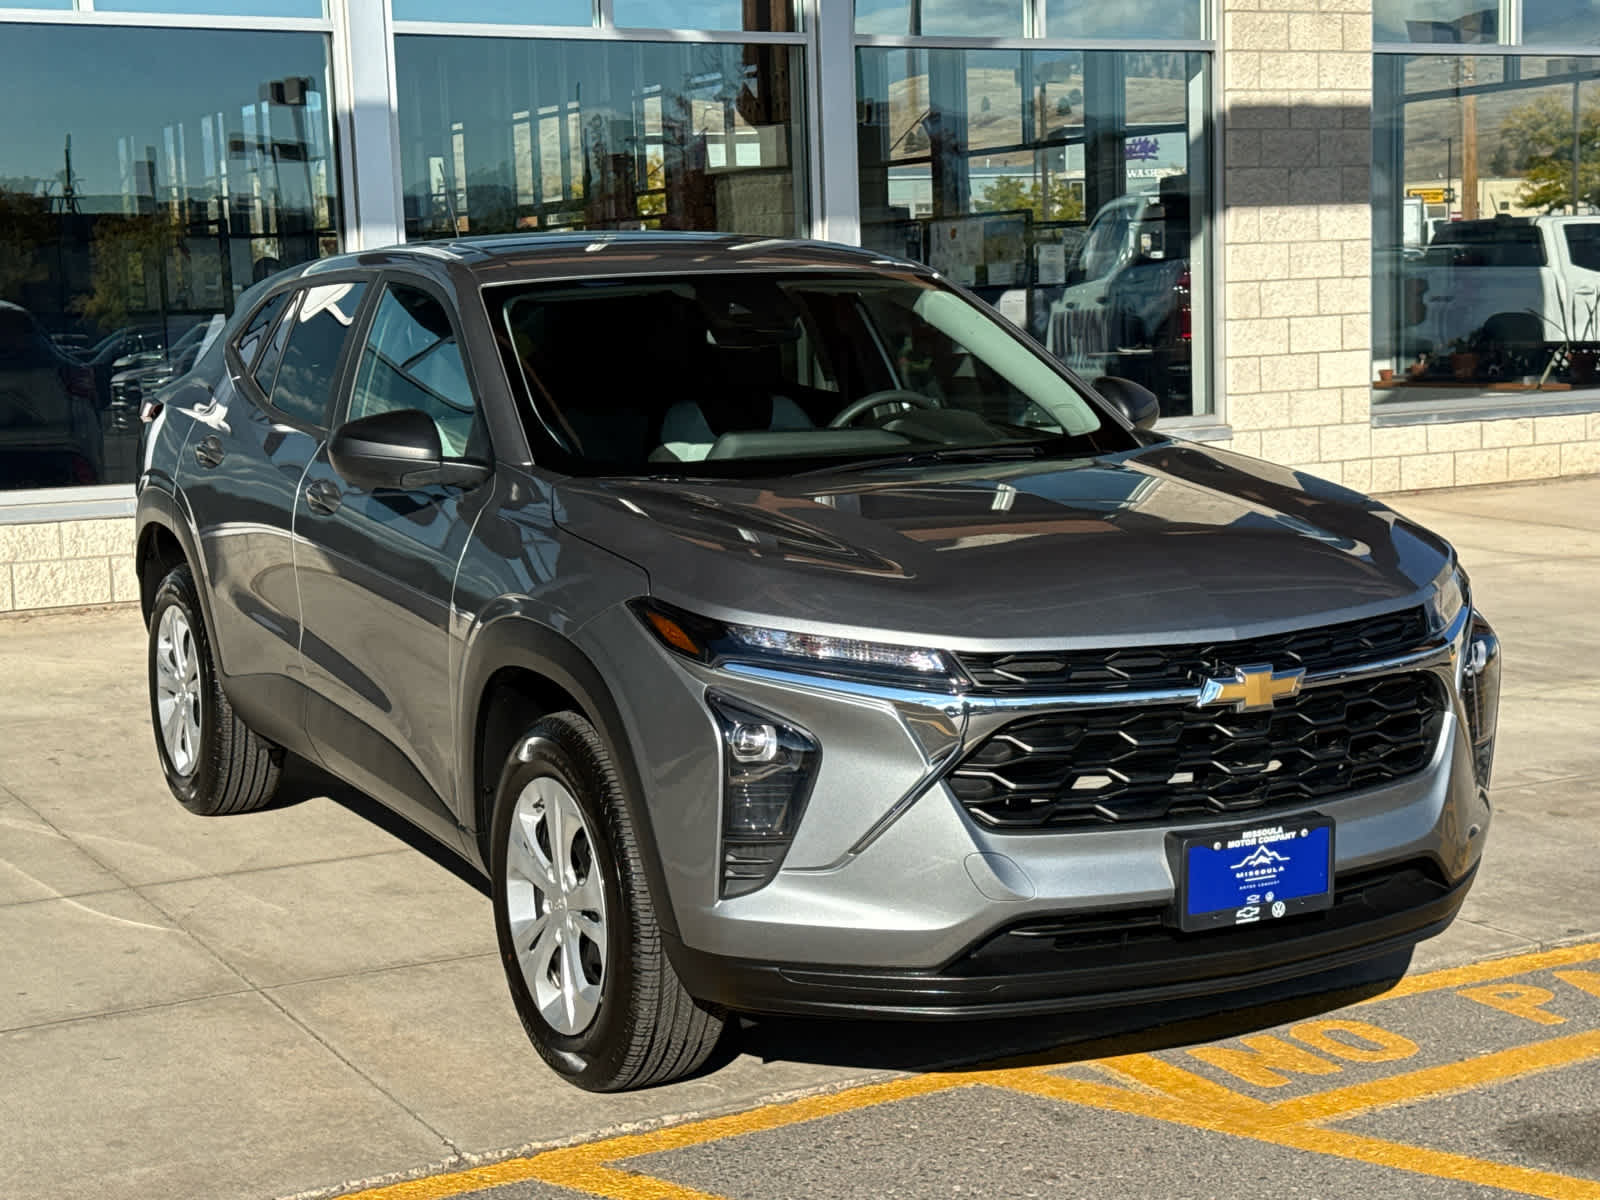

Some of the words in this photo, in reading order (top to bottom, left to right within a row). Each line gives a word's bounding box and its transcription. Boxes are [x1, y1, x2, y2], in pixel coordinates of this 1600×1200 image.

[1227, 838, 1257, 848] MOTOR
[1258, 831, 1297, 844] COMPANY
[1242, 826, 1283, 839] MISSOULA
[1235, 866, 1285, 878] MISSOULA
[1185, 1019, 1420, 1088] NO
